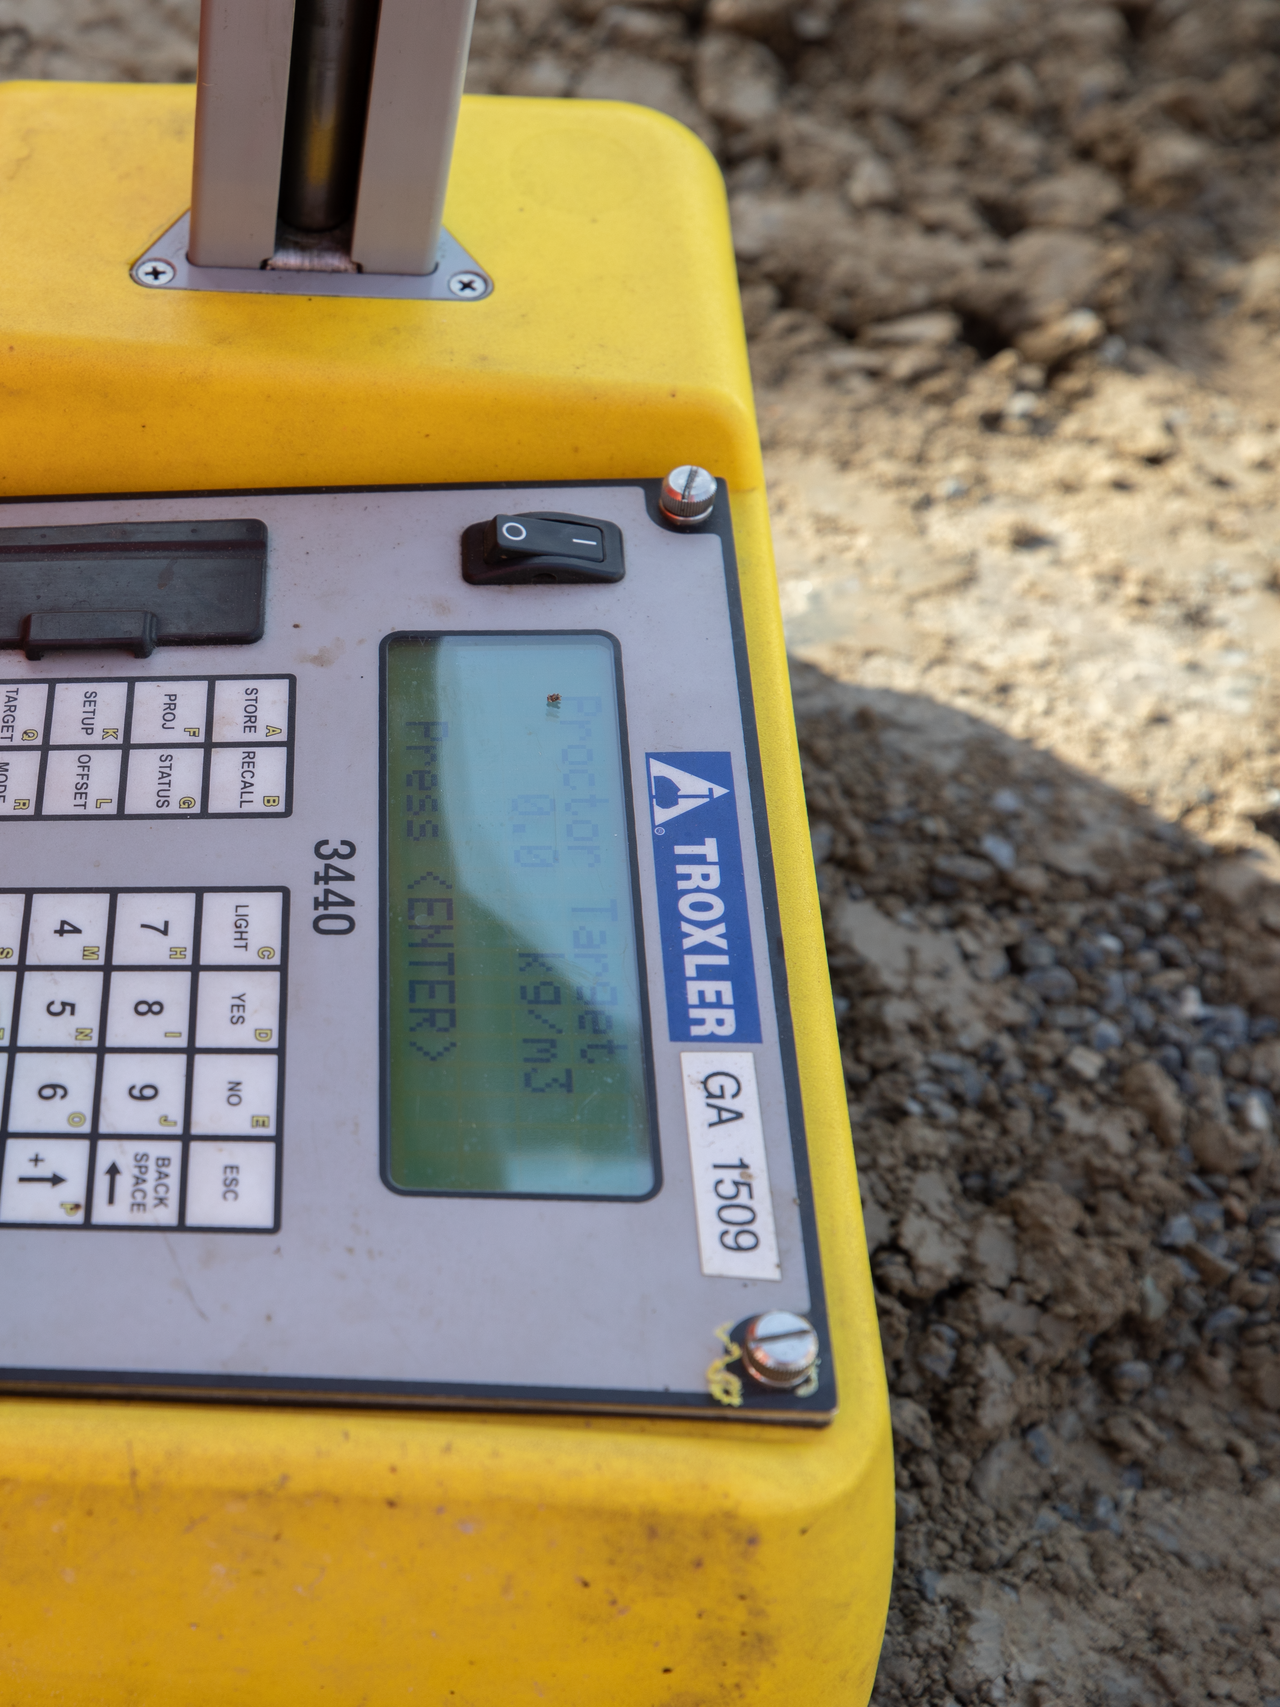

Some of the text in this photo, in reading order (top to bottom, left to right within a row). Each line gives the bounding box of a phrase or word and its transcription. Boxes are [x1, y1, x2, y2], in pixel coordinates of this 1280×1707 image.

[0, 687, 19, 742] TARGET
[81, 691, 98, 736] SETUP
[162, 693, 177, 730] PROJ
[243, 687, 258, 734] STORE
[20, 729, 38, 741] Q
[101, 728, 119, 739] K
[183, 727, 200, 737] F
[265, 725, 282, 736] A
[74, 754, 91, 810] OFFSET
[156, 754, 173, 808] STATUS
[239, 750, 256, 809] RECALL
[13, 799, 30, 810] R
[95, 798, 112, 808] L
[178, 796, 196, 810] G
[262, 796, 279, 807] B
[312, 839, 356, 936] 3440
[559, 696, 629, 1064] Proctor Target
[405, 720, 457, 1062] Press <ENTER>
[53, 920, 82, 937] 4
[140, 920, 169, 937] 7
[233, 904, 250, 951] LIGHT
[673, 837, 737, 1038] TROXLER
[82, 946, 100, 960] M
[169, 946, 187, 959] H
[258, 946, 275, 959] C
[46, 1000, 76, 1017] 5
[134, 1000, 164, 1016] 8
[230, 992, 246, 1025] YES
[519, 951, 574, 1094] kg/m3
[75, 1028, 93, 1041] N
[255, 1029, 272, 1041] D
[38, 1083, 68, 1100] 6
[128, 1084, 159, 1101] 9
[226, 1081, 242, 1107] NO
[159, 1115, 177, 1127] J
[252, 1115, 270, 1128] E
[703, 1070, 761, 1253] GA 1509
[130, 1153, 149, 1213] SPACE
[153, 1157, 171, 1208] BACK
[222, 1165, 239, 1202] ESC
